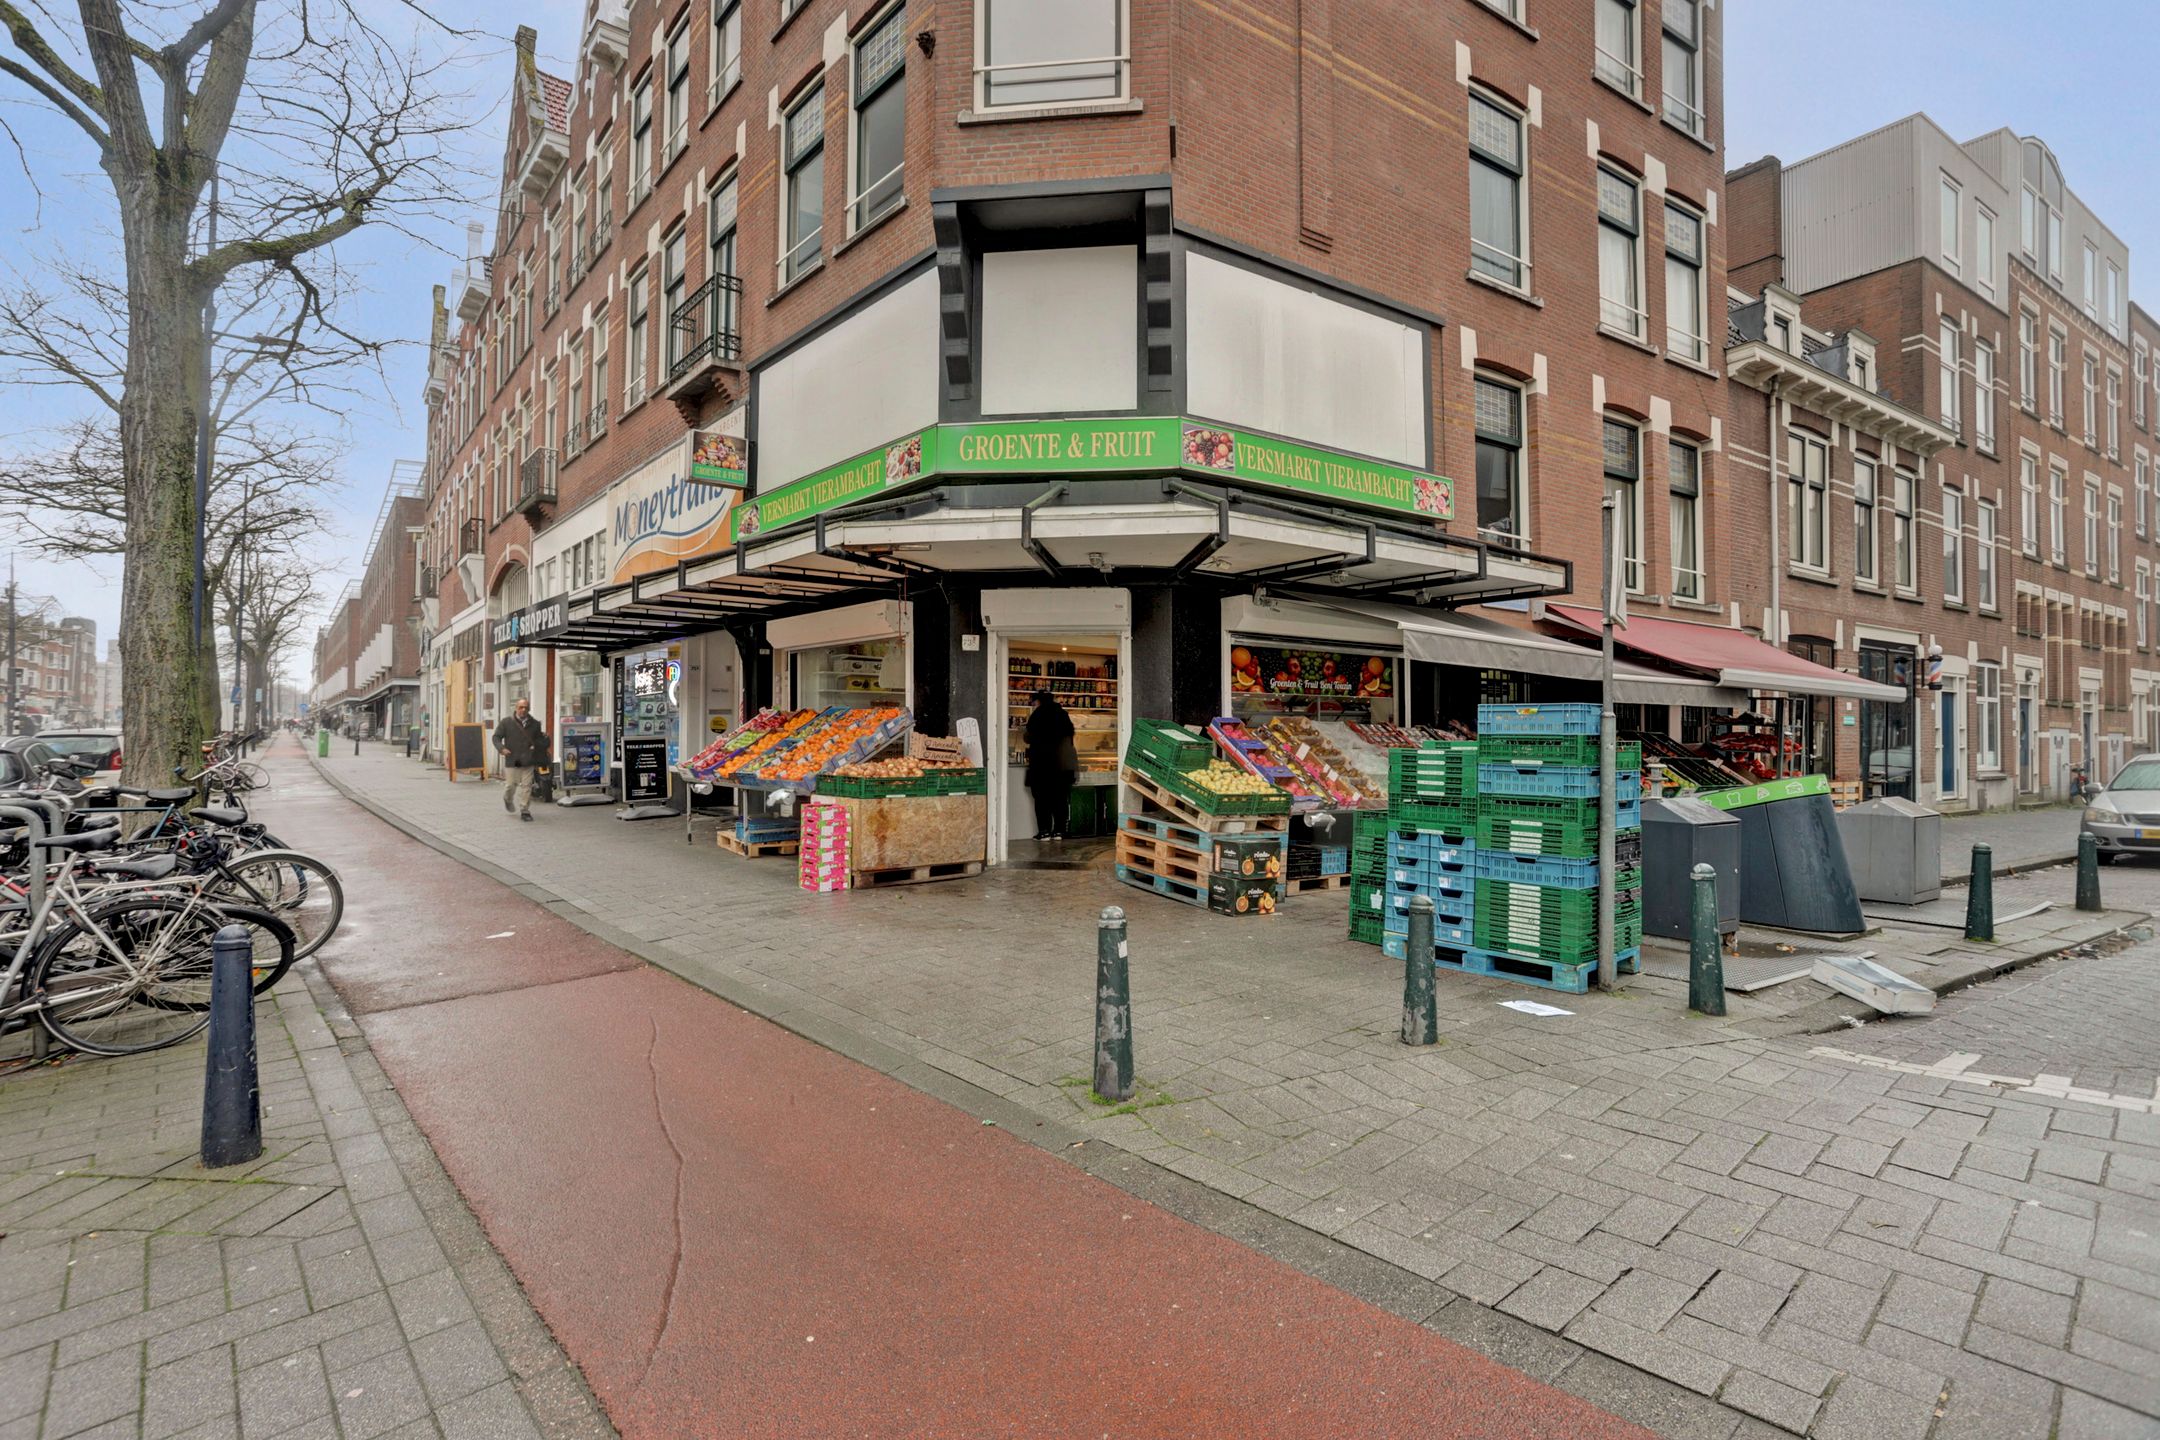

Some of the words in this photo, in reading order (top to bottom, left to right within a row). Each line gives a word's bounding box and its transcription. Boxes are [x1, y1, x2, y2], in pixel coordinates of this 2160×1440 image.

[959, 432, 1061, 461] GROENTE
[1067, 432, 1084, 459] &
[1090, 430, 1156, 458] FRUIT
[762, 486, 811, 523] VERSMARKT
[812, 459, 882, 506] VIERAMBACHT
[1237, 441, 1322, 484] VERSMARKT
[1323, 461, 1412, 502] VIERAMBACHT
[494, 621, 512, 645] TELE
[520, 603, 561, 636] SHOPPER
[1269, 677, 1297, 689] Groenten
[1297, 678, 1303, 688] &
[1304, 679, 1319, 689] Fruit
